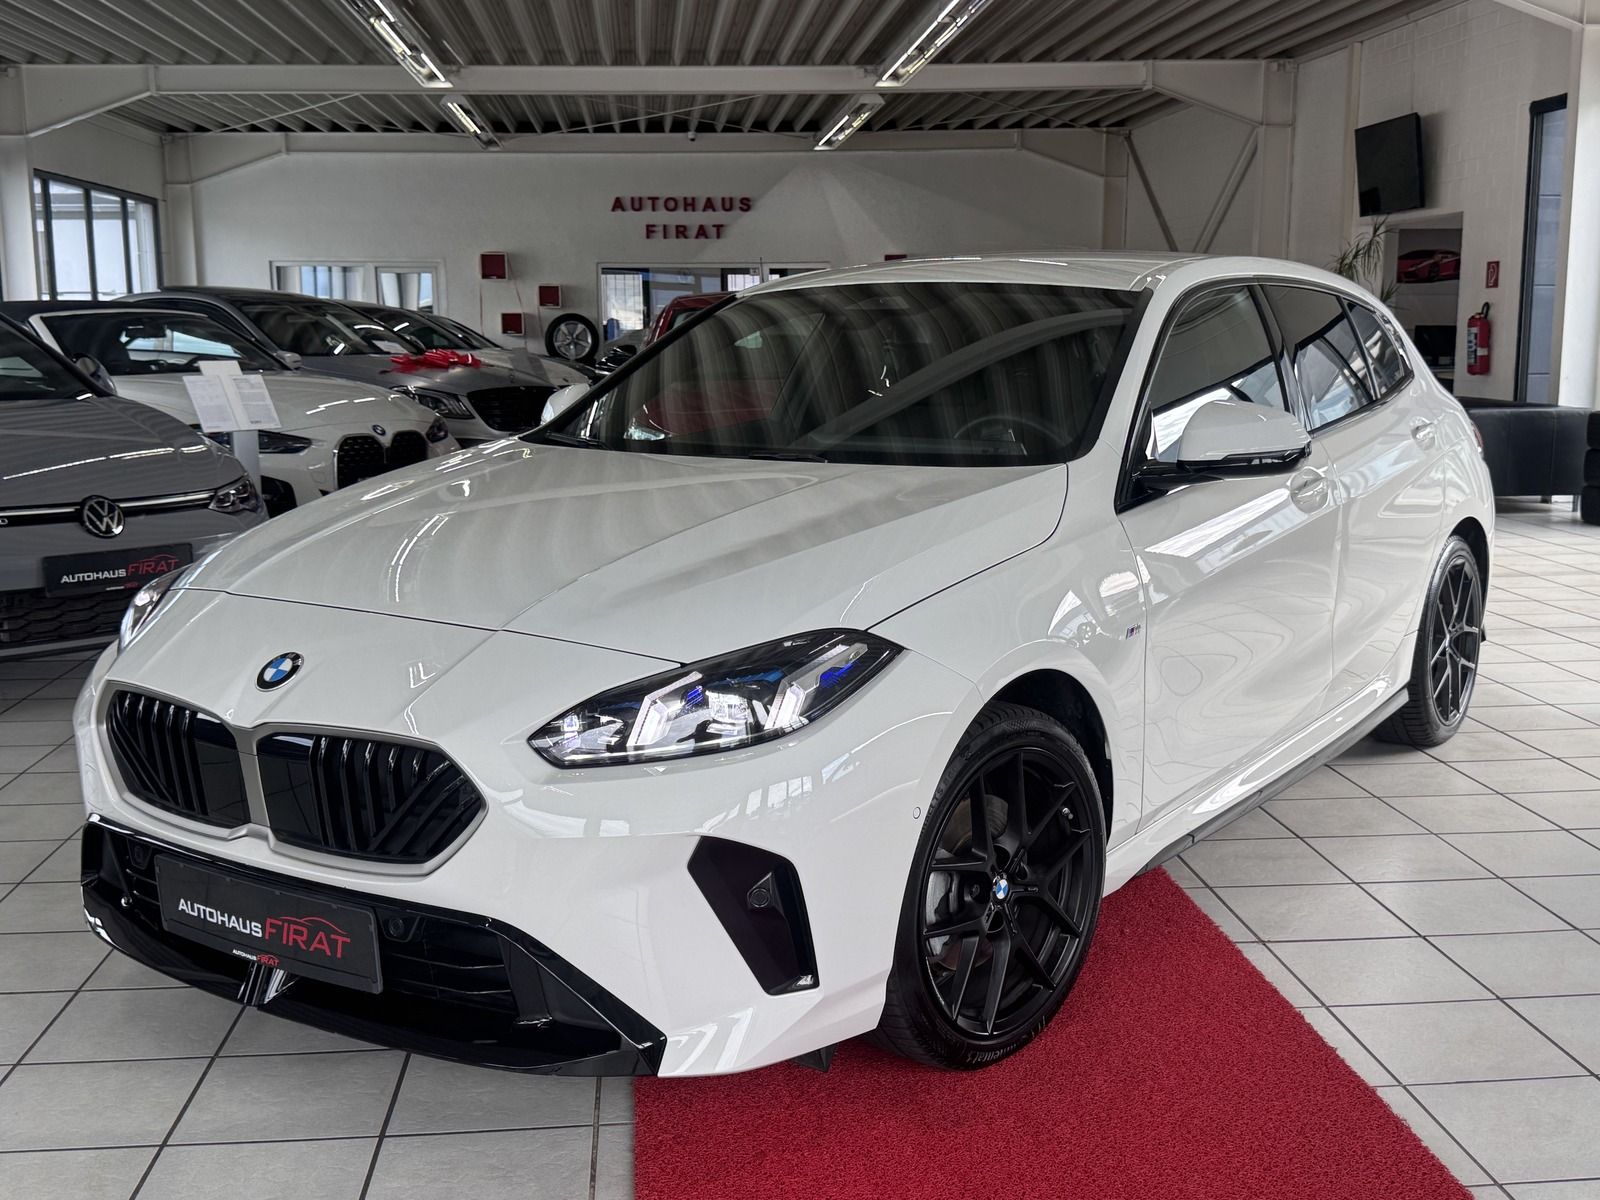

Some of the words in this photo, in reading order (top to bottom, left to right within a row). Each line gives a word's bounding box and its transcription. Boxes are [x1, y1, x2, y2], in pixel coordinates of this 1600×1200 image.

[611, 196, 753, 213] AUTOHAUS
[645, 223, 725, 240] FIRAT
[60, 568, 127, 584] AUTOHAUS
[127, 556, 179, 576] FIRAT
[177, 898, 263, 938] AUTOHAUS
[264, 917, 351, 960] FIRAT
[232, 948, 257, 961] AUTOHAUS
[256, 954, 280, 967] FIRAT
